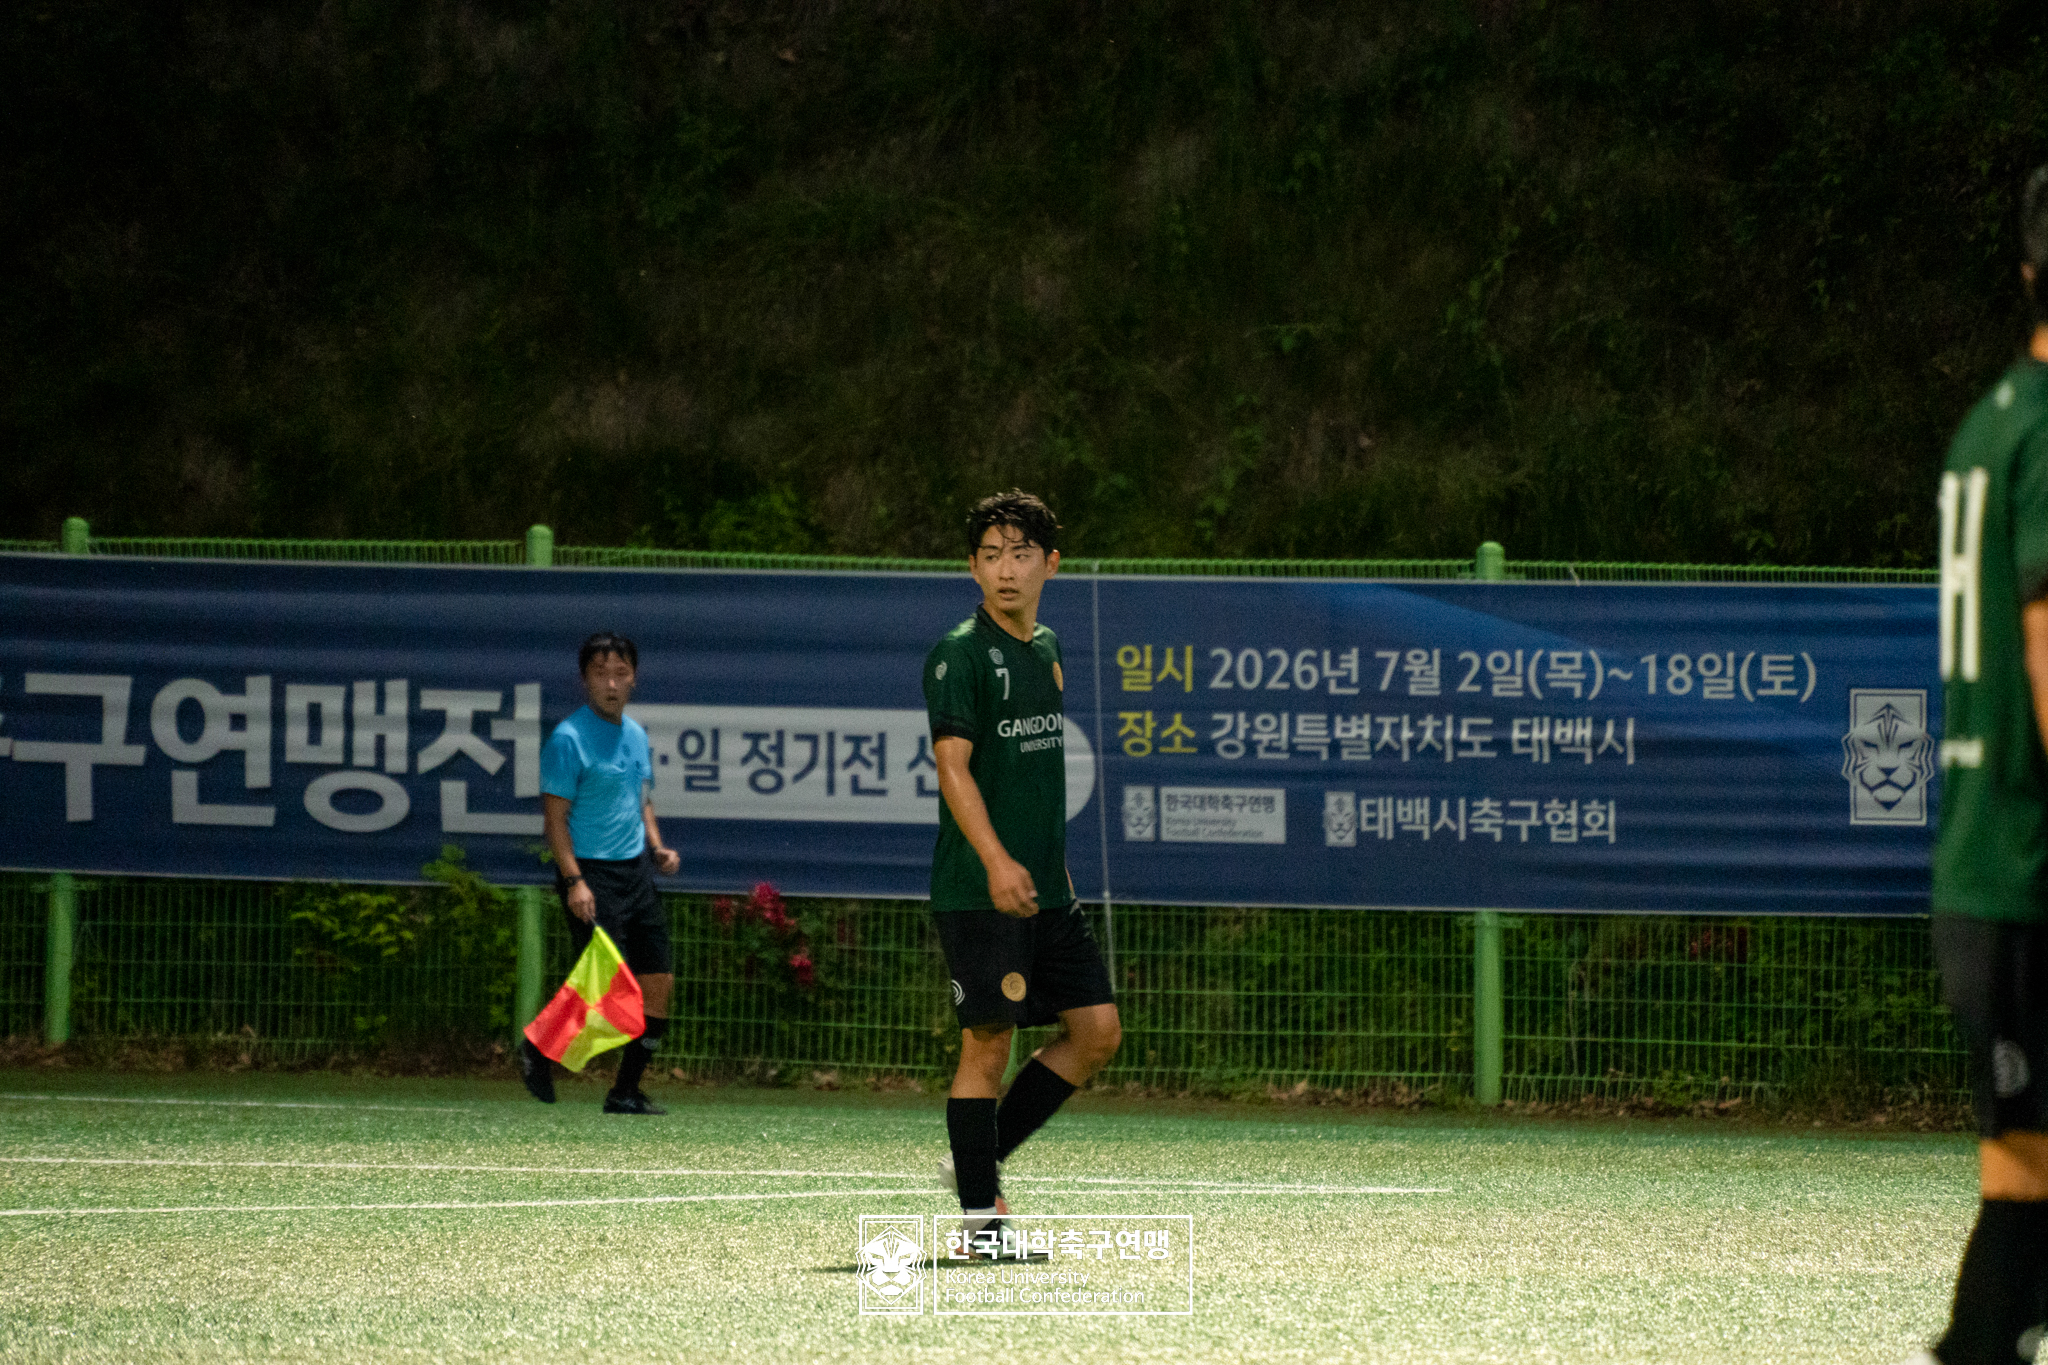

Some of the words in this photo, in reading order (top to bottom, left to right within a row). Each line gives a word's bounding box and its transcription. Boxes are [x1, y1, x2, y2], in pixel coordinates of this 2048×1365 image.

[995, 667, 1010, 700] 7
[1116, 644, 1194, 692] 일시
[1208, 647, 1360, 695] 2026년
[1375, 648, 1442, 696] 7월
[1456, 648, 1817, 703] 2일(목)~18일(토)
[0, 672, 545, 836] 구연맹전
[740, 730, 889, 796] 정기전
[1117, 710, 1198, 758] 장소
[1210, 712, 1498, 763] 강원특별자치도
[1511, 716, 1635, 765] 태백시
[1358, 797, 1617, 844] 태백시축구협회
